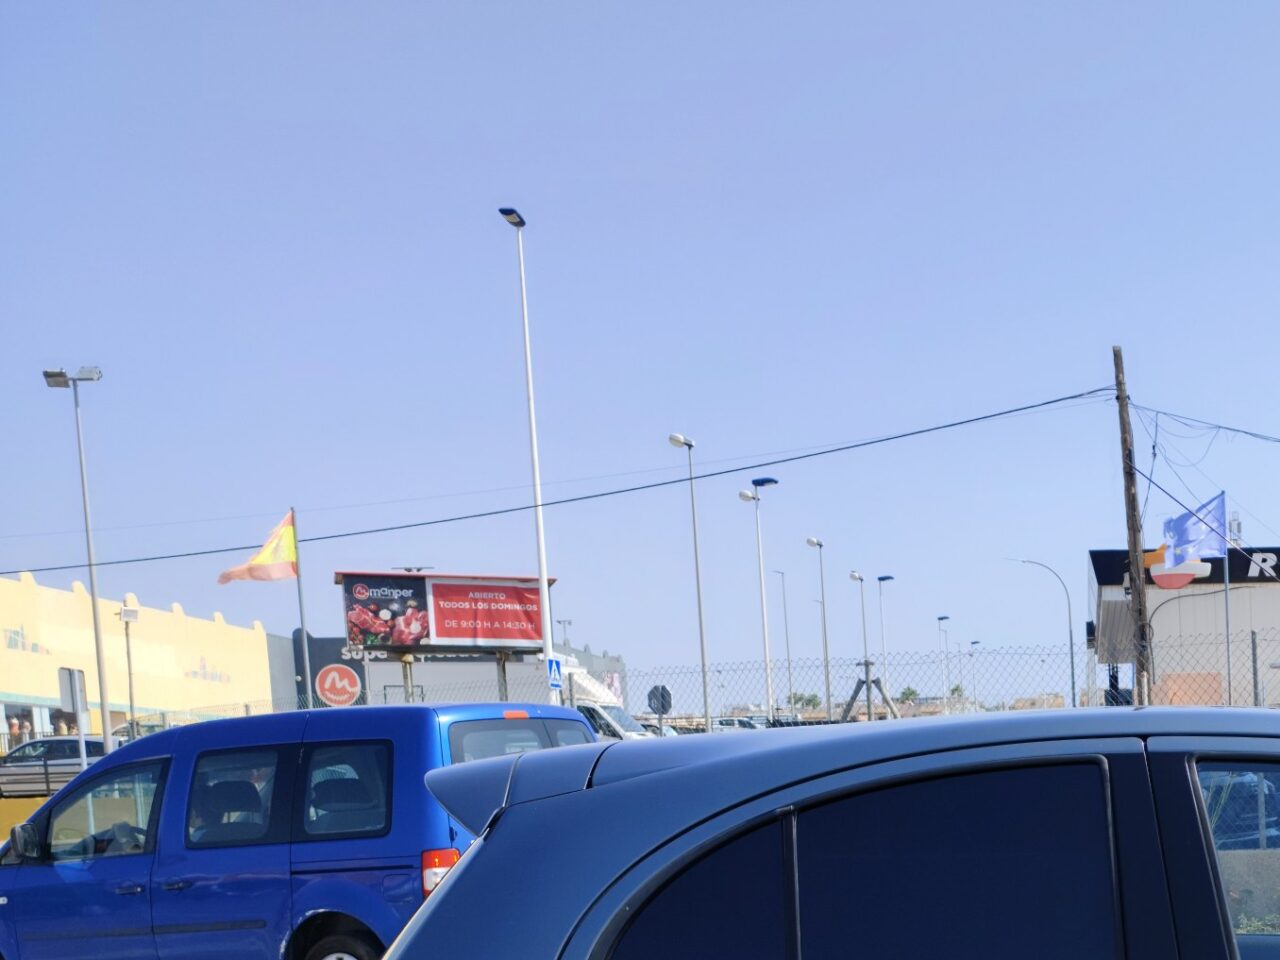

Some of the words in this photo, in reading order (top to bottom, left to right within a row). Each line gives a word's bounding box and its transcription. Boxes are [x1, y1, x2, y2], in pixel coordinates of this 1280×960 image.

[468, 591, 506, 600] ABIERTO
[439, 600, 471, 609] TODOS
[472, 601, 489, 609] LOS
[491, 602, 538, 611] DOMINGOS
[445, 619, 459, 628] DE
[483, 620, 492, 629] H
[494, 620, 501, 629] A
